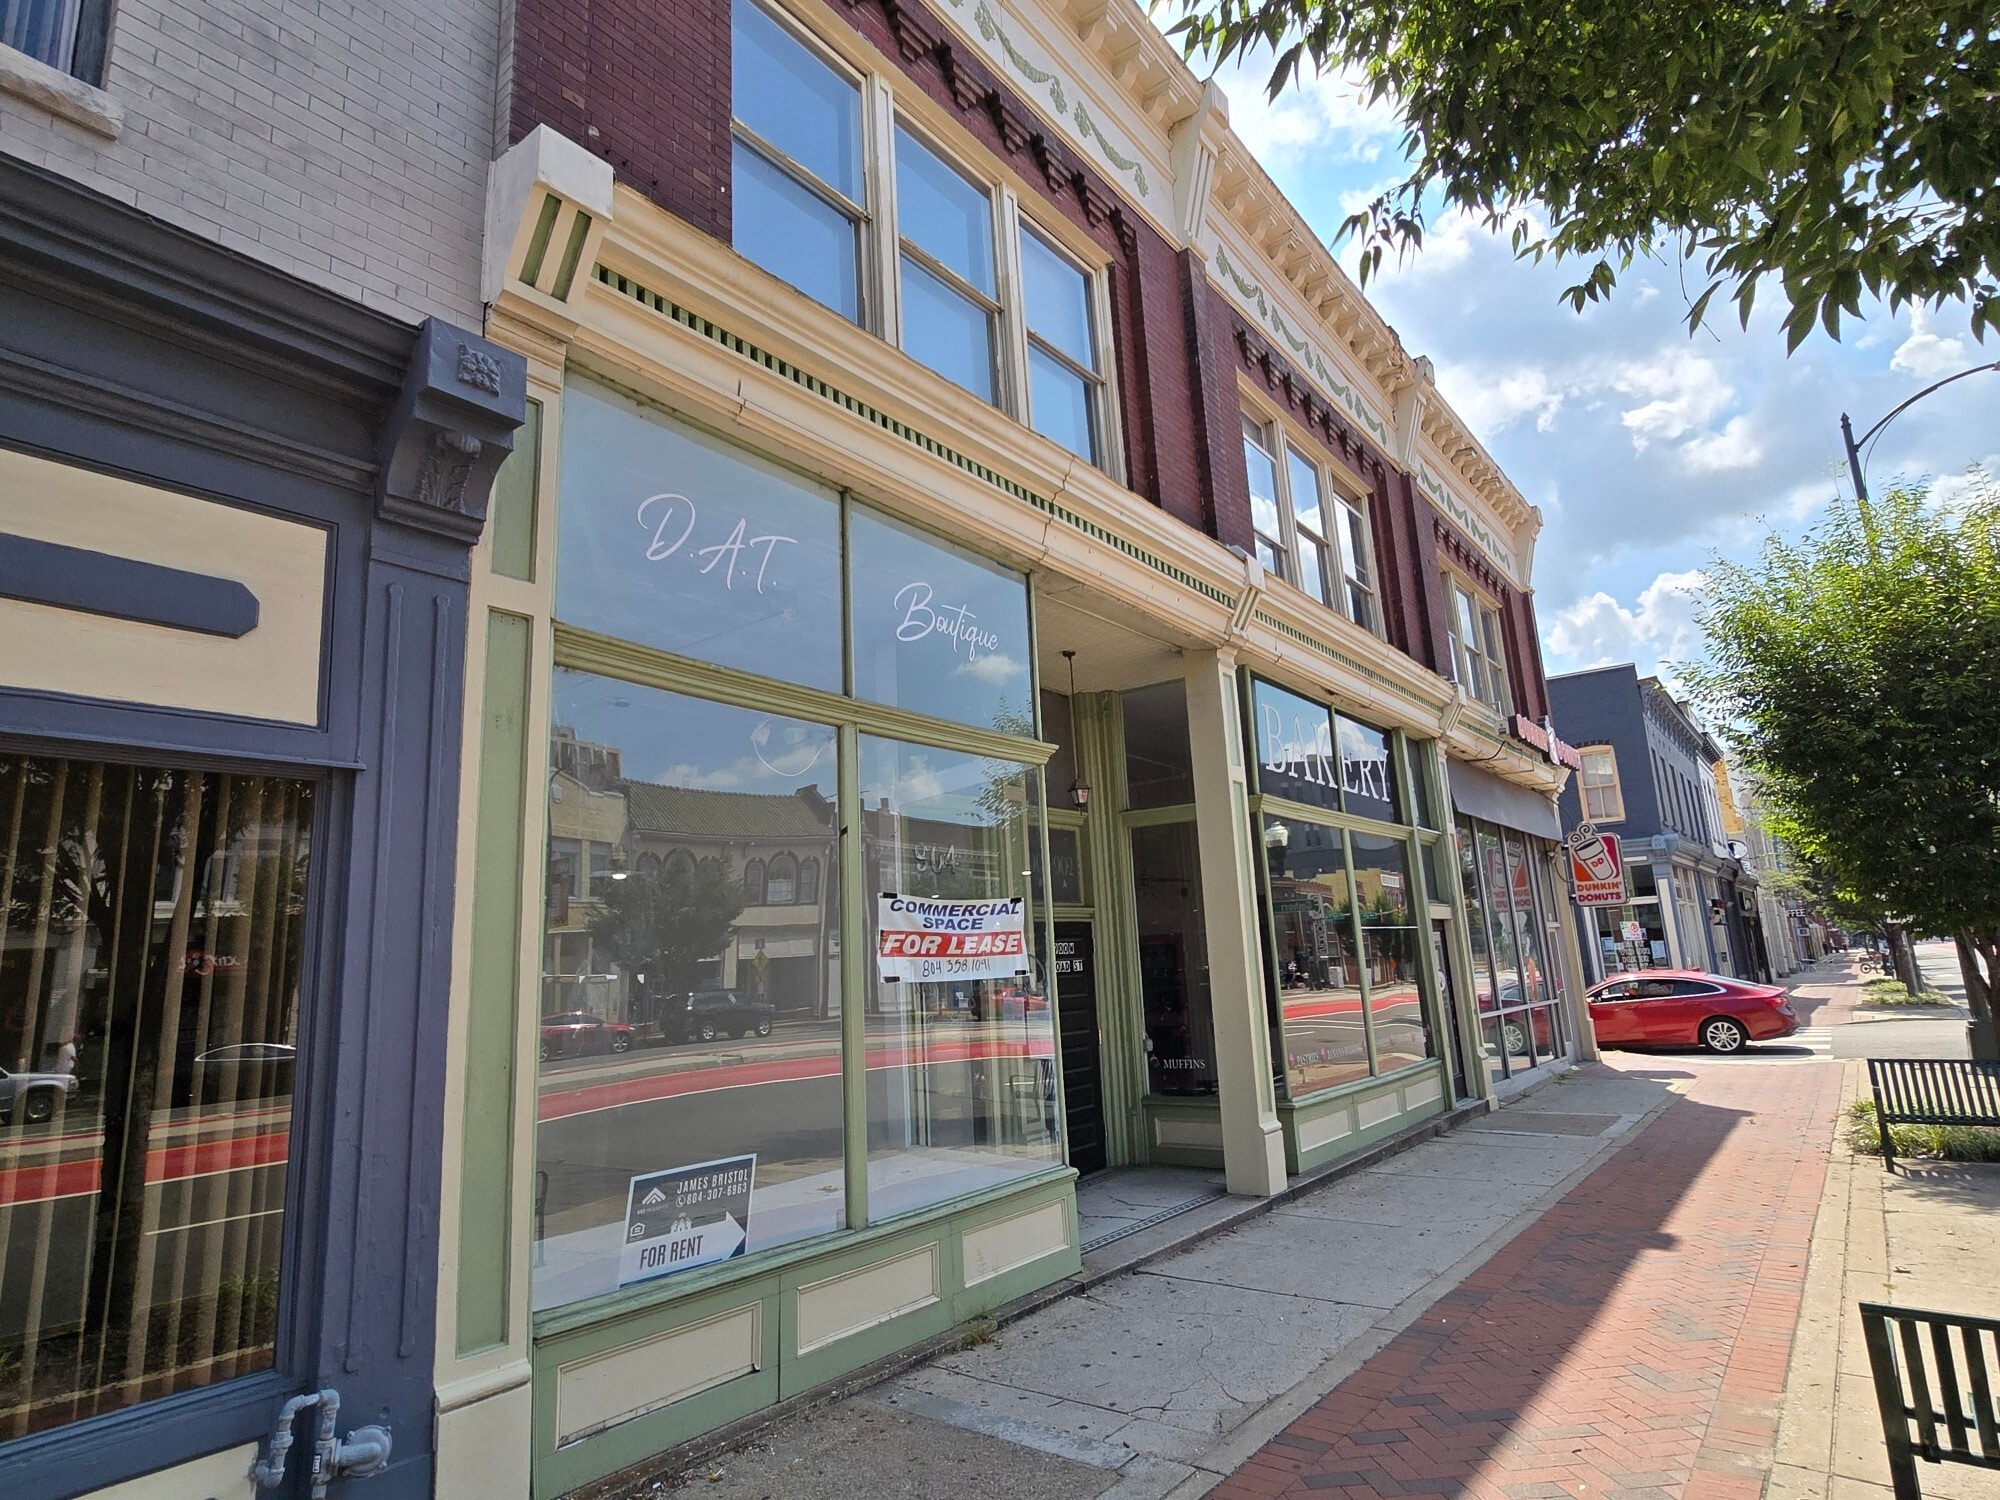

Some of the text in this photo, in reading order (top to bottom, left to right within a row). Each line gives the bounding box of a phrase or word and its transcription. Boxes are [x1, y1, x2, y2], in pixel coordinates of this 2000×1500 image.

[893, 581, 999, 662] Boutique
[1260, 702, 1391, 803] BAKERY
[914, 842, 957, 874] 904
[1591, 857, 1605, 868] DD
[1576, 881, 1622, 892] DUNKIN'
[1577, 891, 1622, 902] DONUTS
[890, 899, 1019, 917] COMMERCIAL
[922, 917, 984, 930] SPACE
[882, 933, 1021, 955] FOR LEASE
[922, 958, 991, 977] 804 358 1091
[1073, 960, 1083, 971] ST
[1163, 1058, 1206, 1069] MUFFINS
[677, 1169, 748, 1195] JAMES BRISTOL
[639, 1235, 704, 1270] FOR RENT
